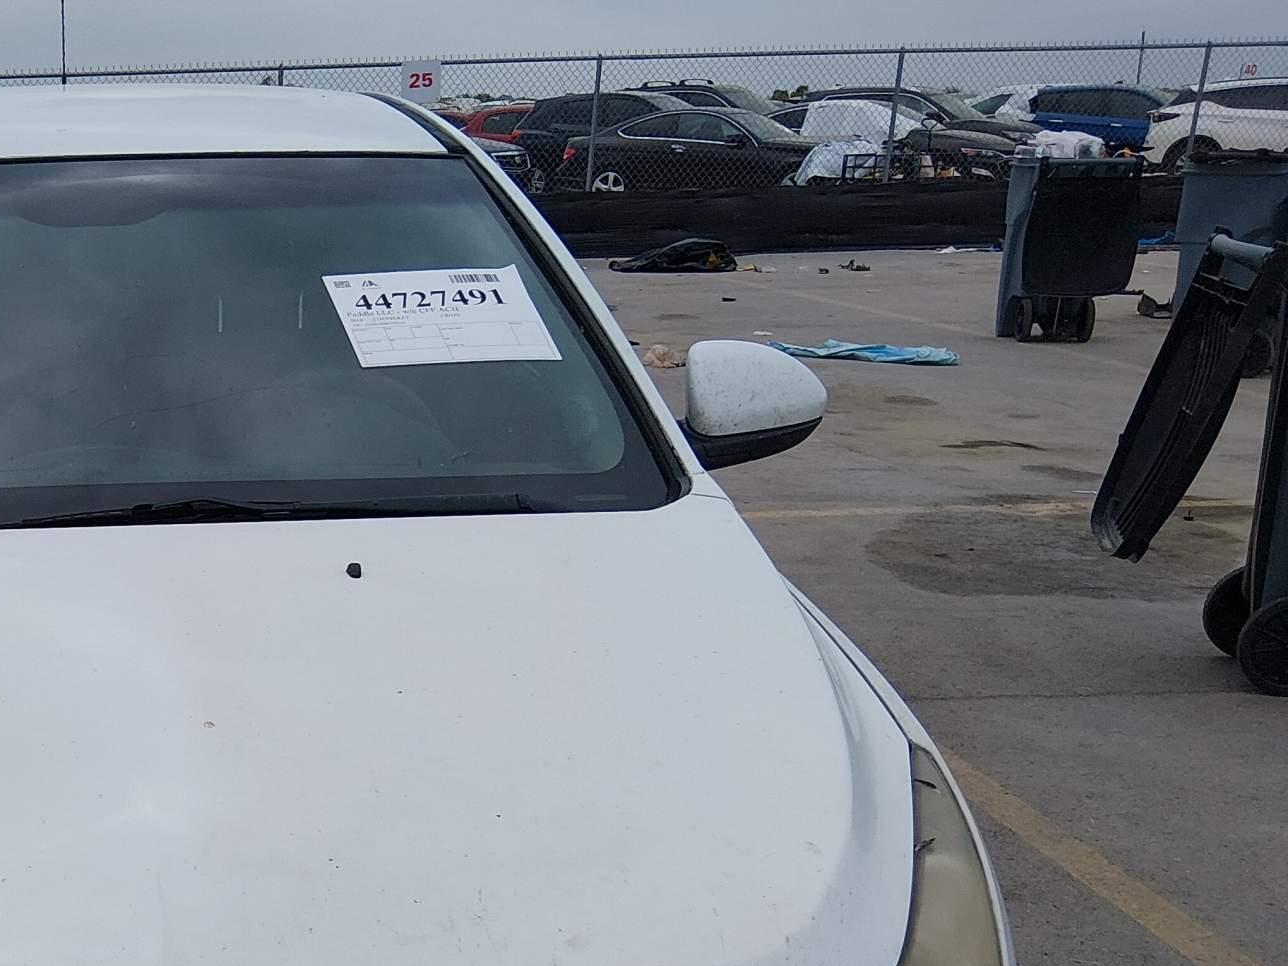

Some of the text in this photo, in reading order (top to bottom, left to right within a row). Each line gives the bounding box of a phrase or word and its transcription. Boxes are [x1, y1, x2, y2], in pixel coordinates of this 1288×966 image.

[1244, 64, 1257, 76] 40
[409, 73, 433, 88] 25
[355, 288, 509, 311] 44727491
